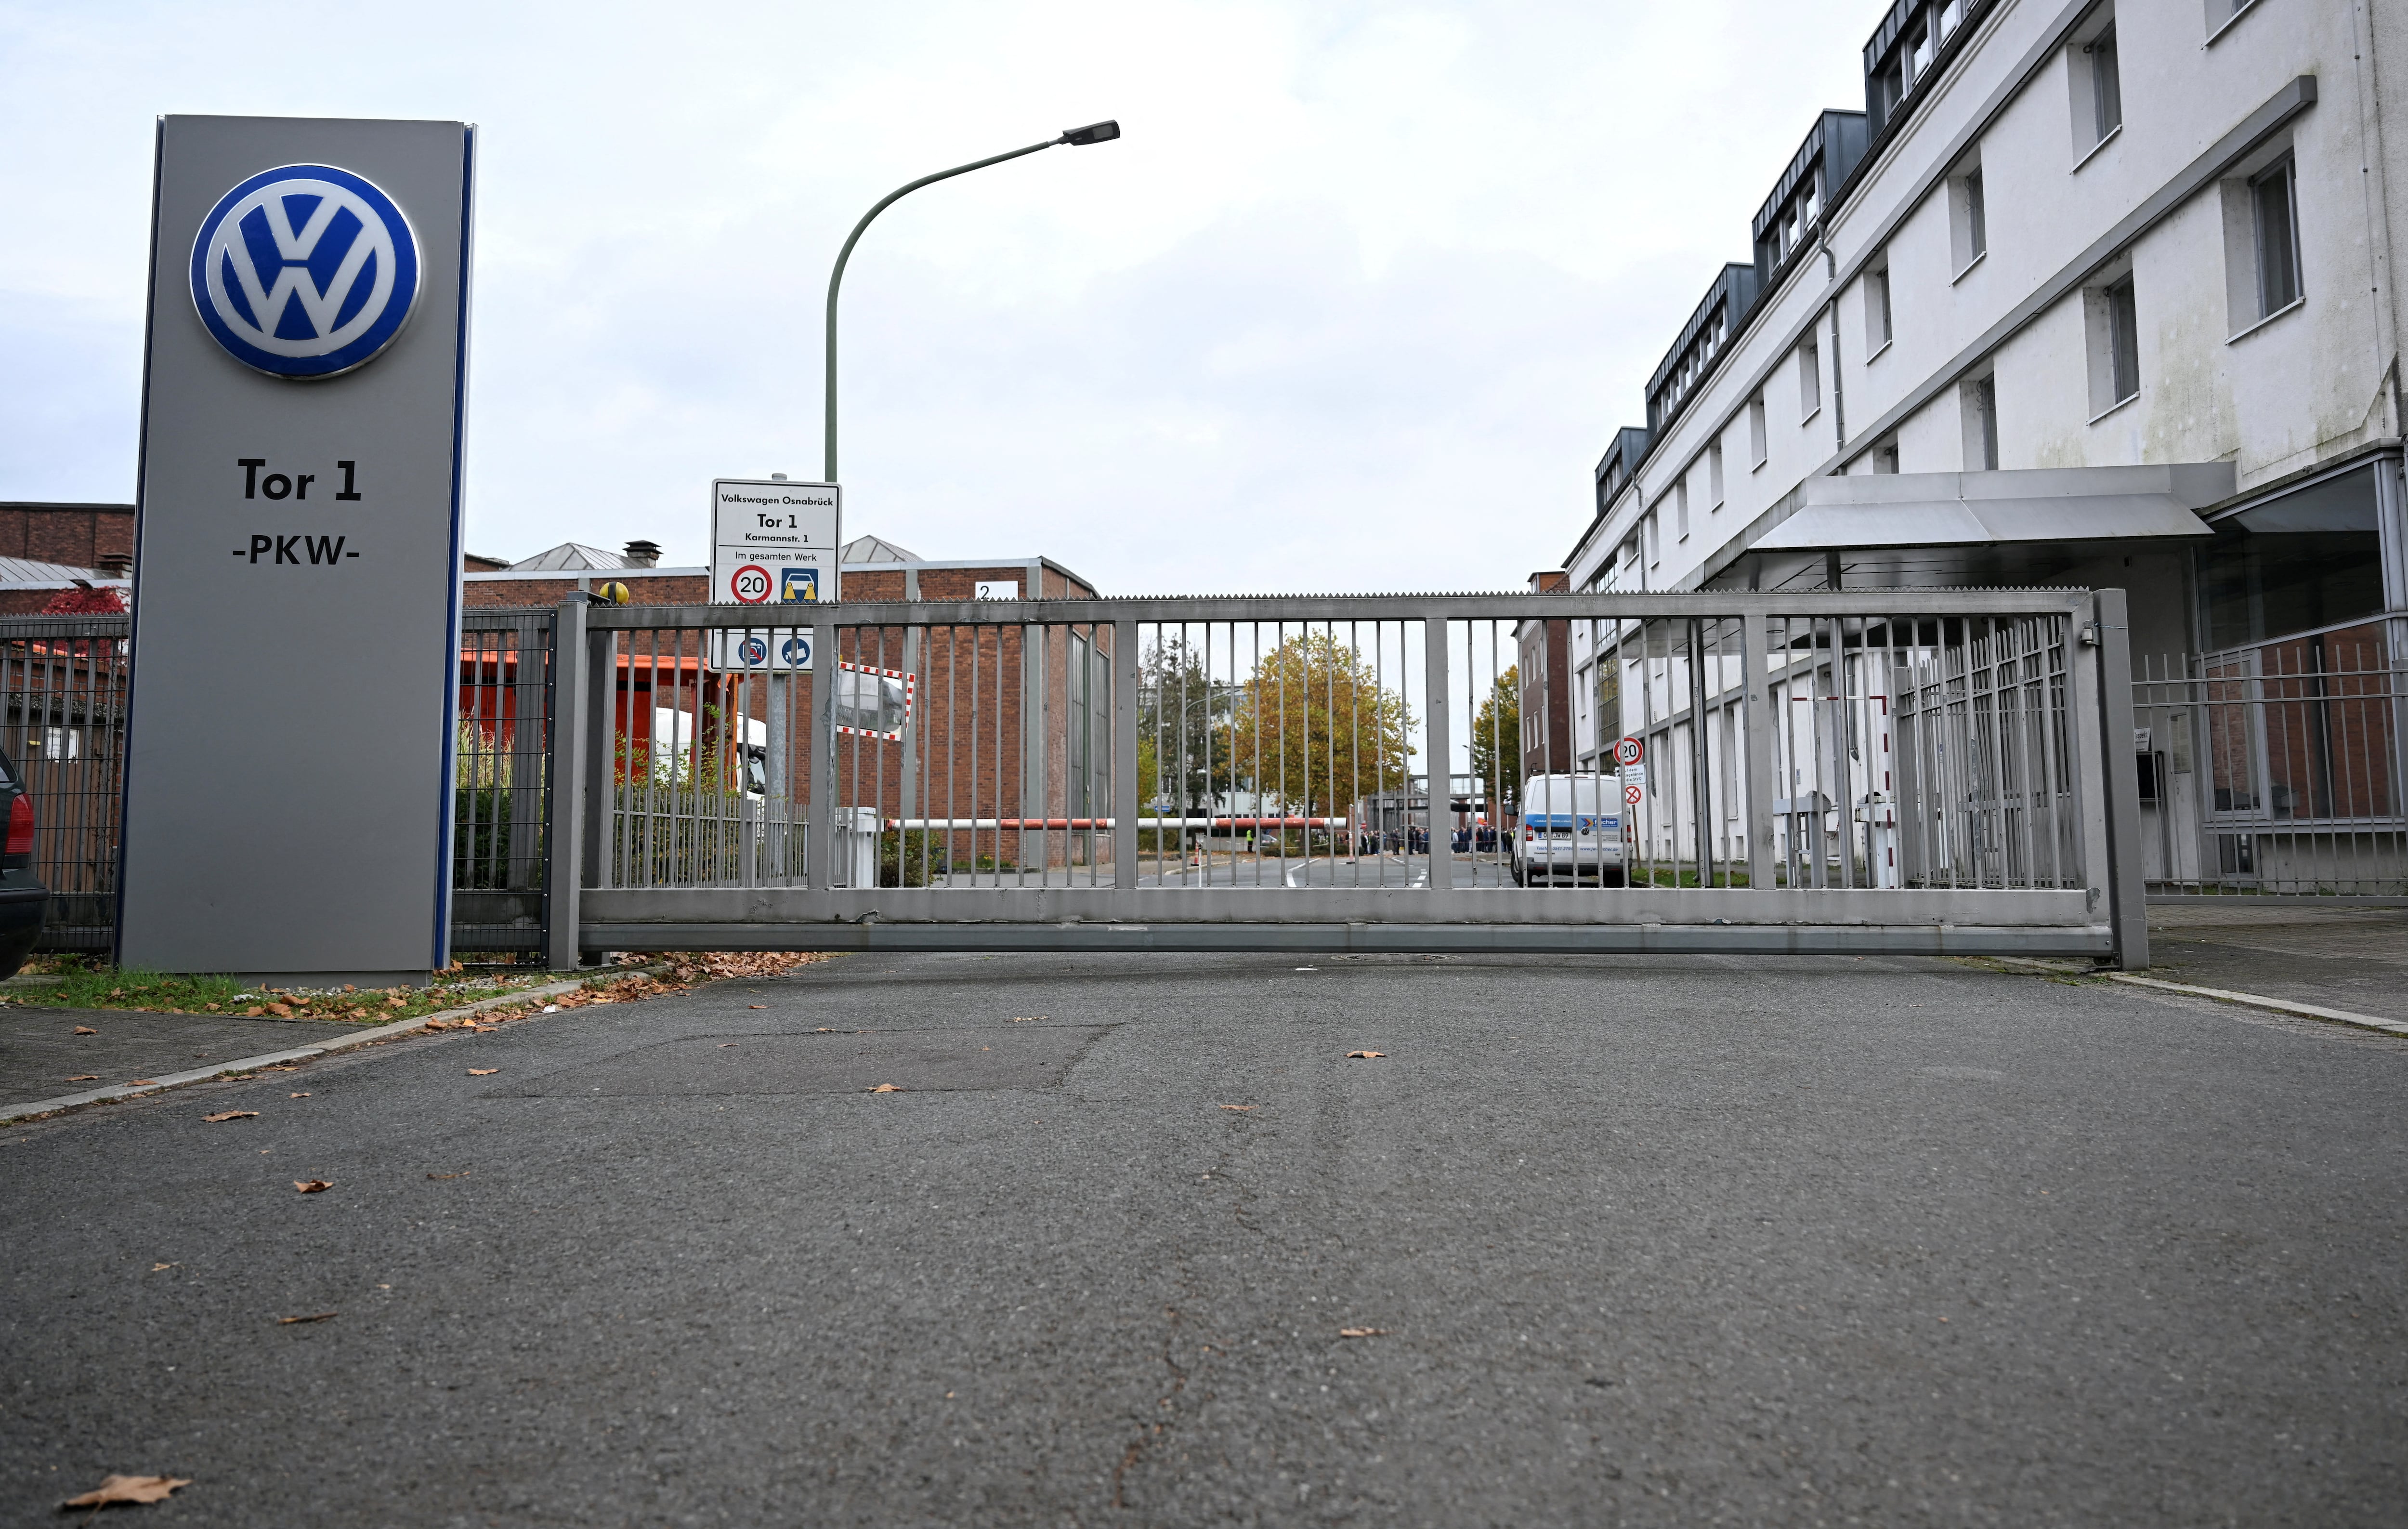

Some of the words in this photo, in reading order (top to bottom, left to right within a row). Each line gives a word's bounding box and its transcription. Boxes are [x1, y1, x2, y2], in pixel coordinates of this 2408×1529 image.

[238, 458, 315, 500] Tor
[336, 461, 361, 501] 1
[721, 494, 779, 505] Volkswagen
[782, 496, 833, 506] Osnabrück
[757, 514, 782, 528] Tor
[788, 515, 797, 528] 1
[745, 533, 800, 542] Karmannstr.
[233, 535, 359, 565] -PKW-
[749, 553, 791, 561] gesamten
[794, 553, 817, 561] Werk
[740, 577, 764, 593] 20
[980, 585, 990, 599] 2
